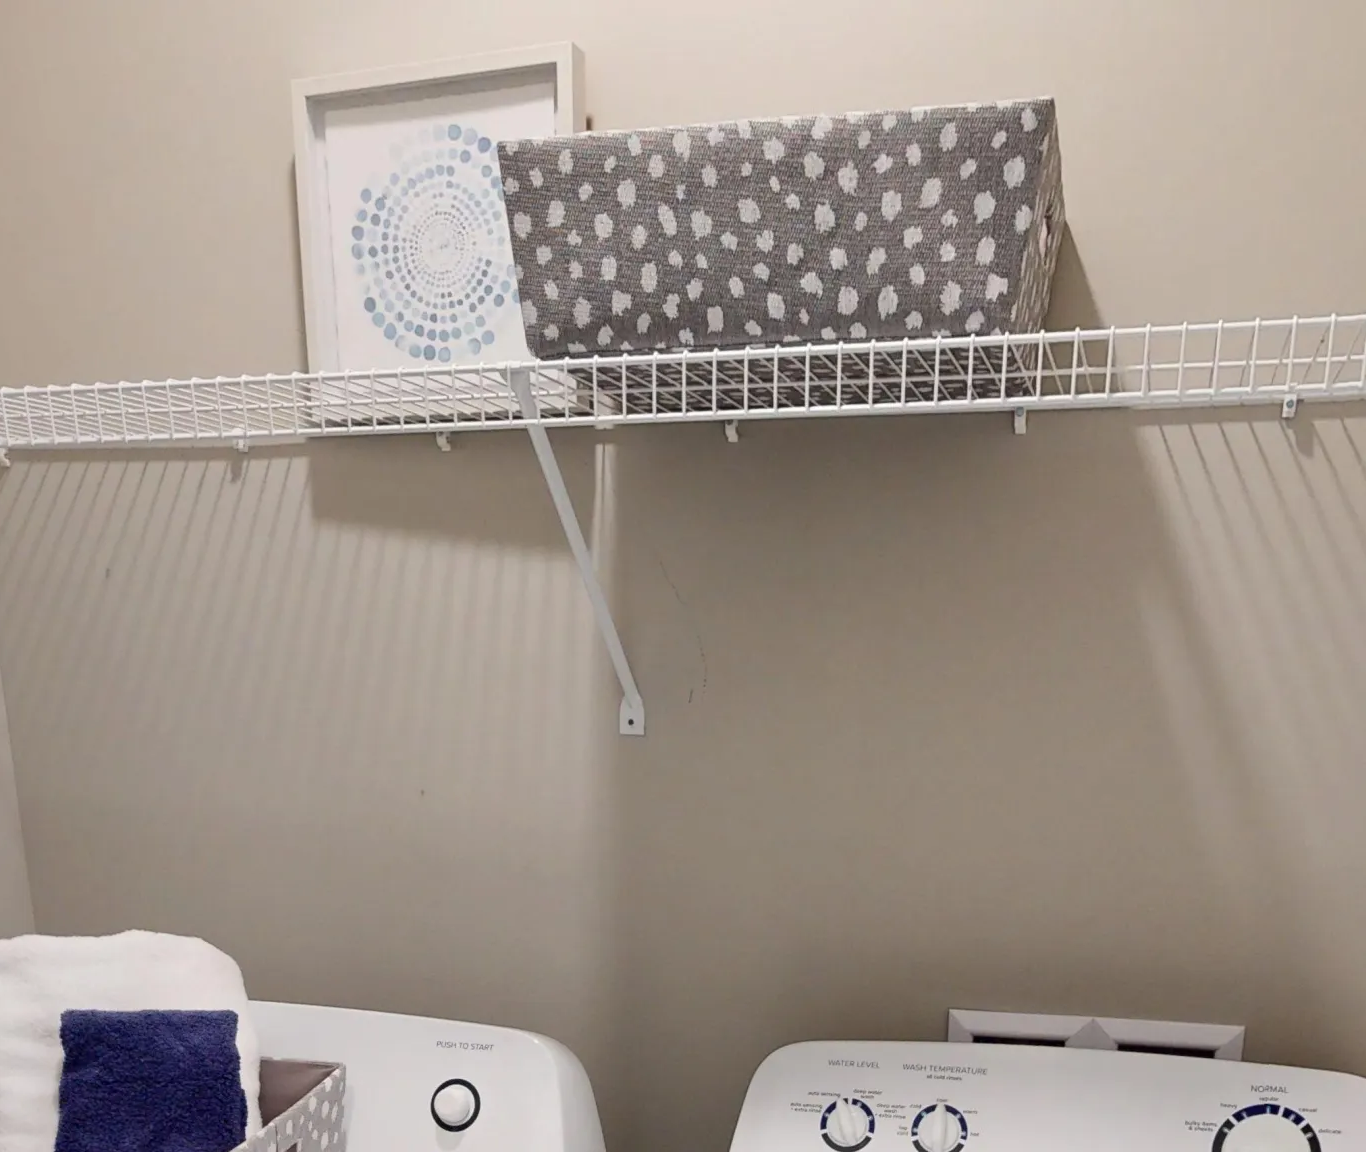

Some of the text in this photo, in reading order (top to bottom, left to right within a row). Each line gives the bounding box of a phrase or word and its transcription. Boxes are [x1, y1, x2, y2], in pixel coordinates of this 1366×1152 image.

[436, 1040, 494, 1051] PUSH TO START
[828, 1059, 880, 1069] WATER LEVEL
[902, 1063, 988, 1076] WASH TEMPERATURE
[1250, 1085, 1289, 1094] NORMAL
